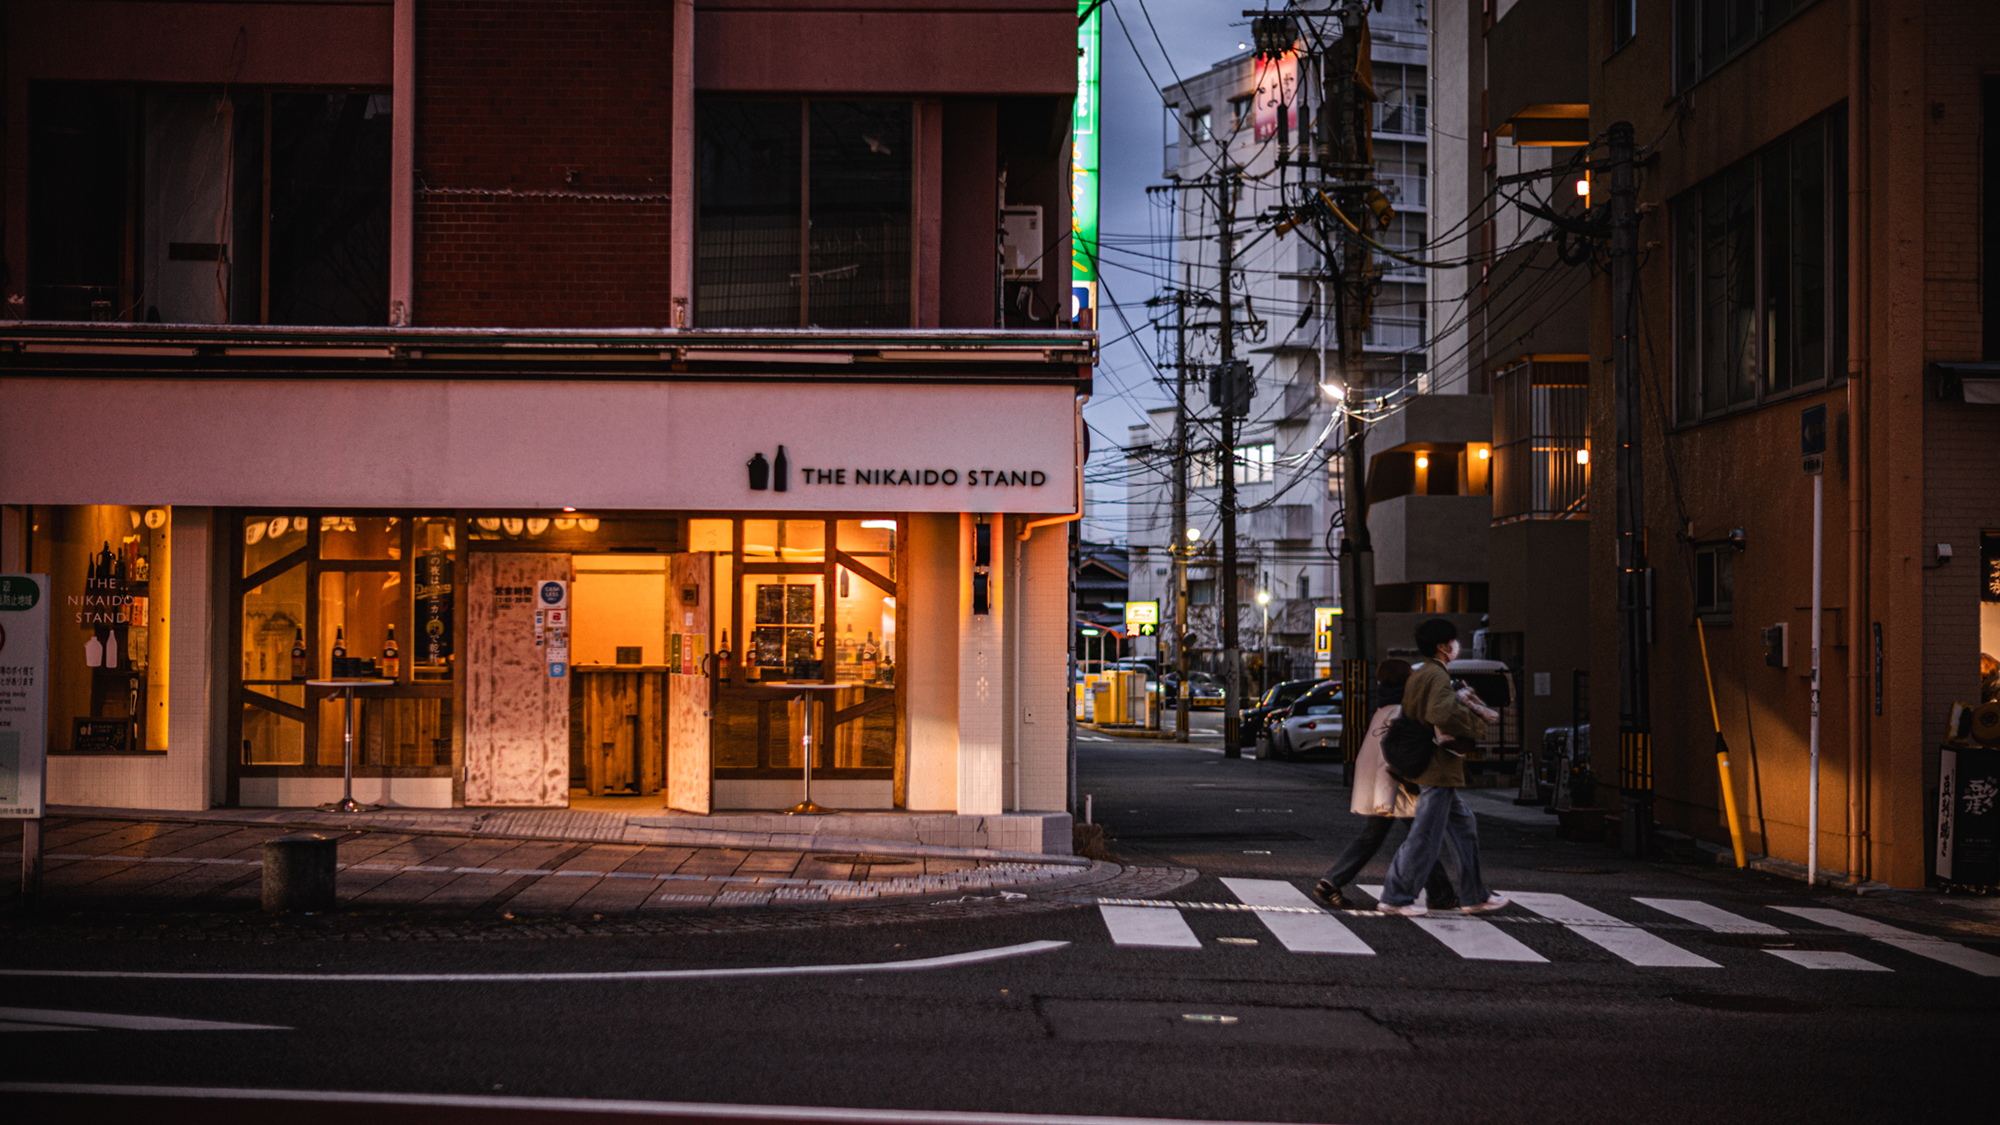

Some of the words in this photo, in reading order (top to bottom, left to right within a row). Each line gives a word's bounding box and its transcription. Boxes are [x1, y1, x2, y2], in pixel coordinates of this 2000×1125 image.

[802, 468, 845, 485] THE
[856, 468, 958, 486] NIKAIDO
[968, 469, 1046, 487] STAND
[87, 577, 117, 590] THE
[494, 586, 533, 596] 営業時間
[67, 595, 135, 607] NIKAIDO
[75, 612, 127, 624] STAND
